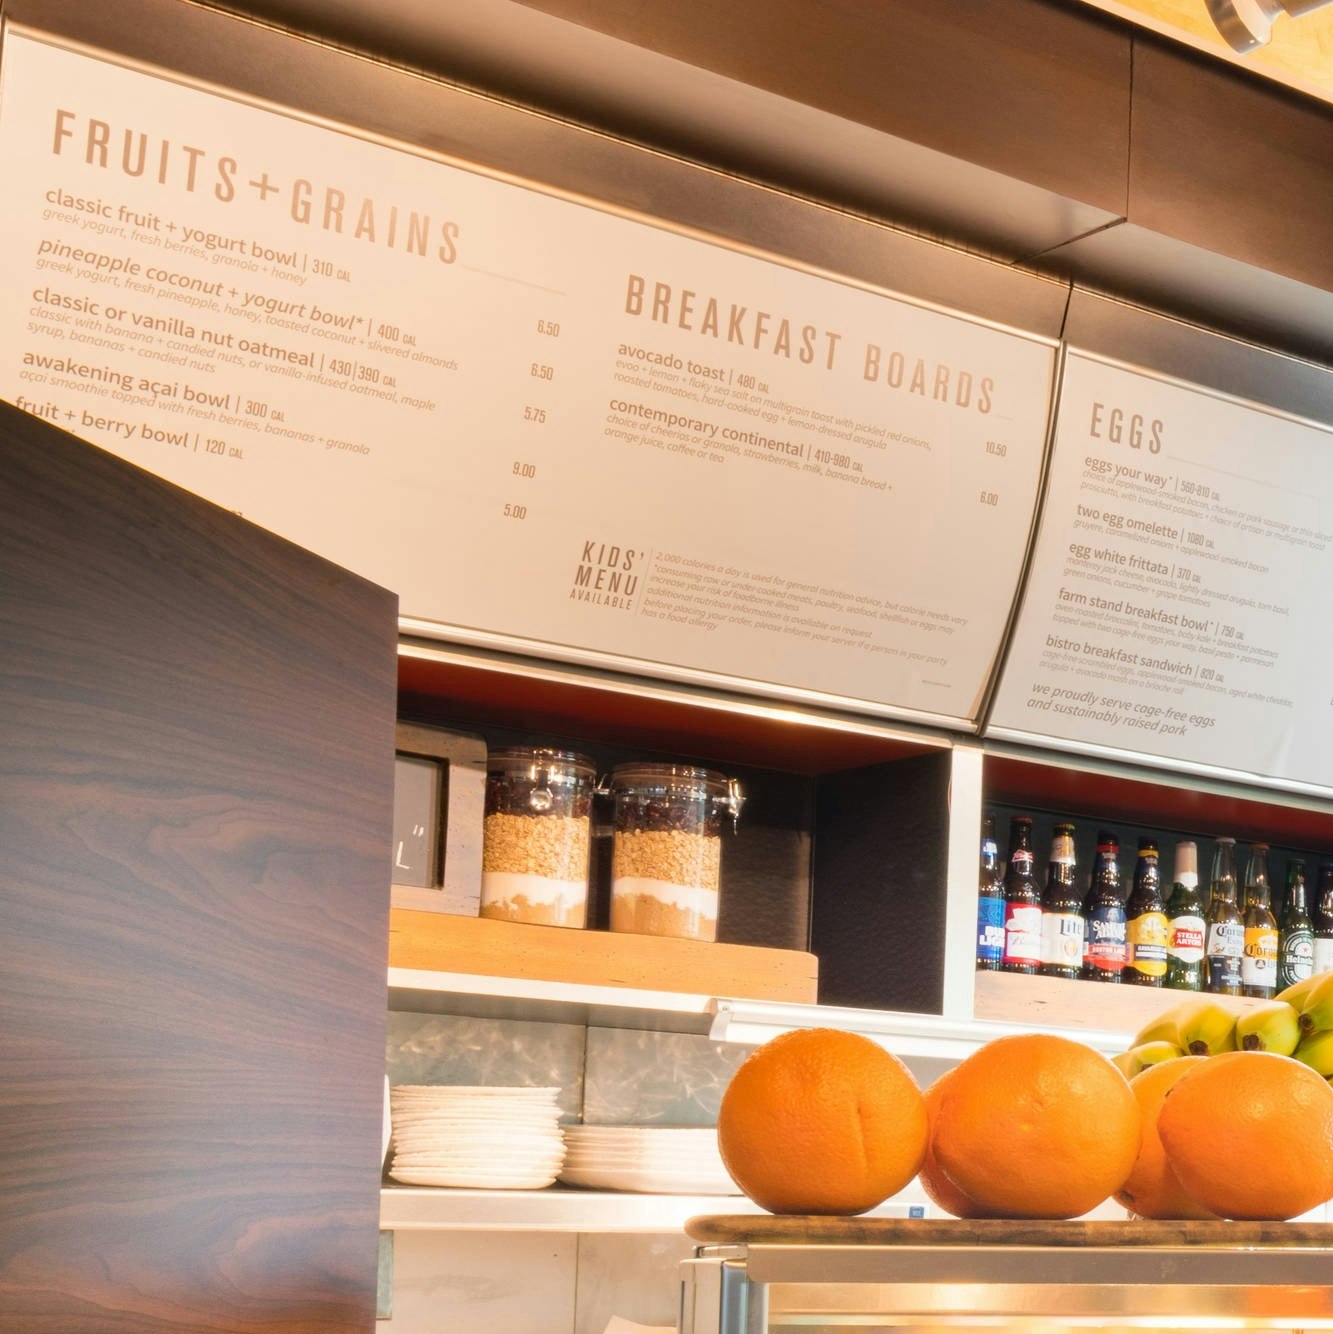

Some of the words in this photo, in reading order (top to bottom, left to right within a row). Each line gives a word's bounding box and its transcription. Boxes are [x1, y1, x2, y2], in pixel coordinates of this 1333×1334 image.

[46, 189, 112, 218] classic
[118, 205, 160, 232] fruit
[182, 226, 246, 255] yogurt
[252, 241, 297, 268] bowl
[312, 259, 333, 277] 310
[37, 239, 141, 275] pineapple
[146, 266, 224, 296] coconut
[243, 291, 306, 317] yogurt
[378, 324, 399, 342] 400
[33, 287, 99, 315] classic
[105, 307, 126, 321] or
[132, 311, 195, 338] vanilla
[201, 329, 234, 349] nut
[238, 341, 314, 368] oatmeal
[537, 320, 560, 338] 6.50
[625, 274, 842, 370] BREAKFAST
[864, 343, 994, 414] BOARDS
[23, 353, 133, 391] awakening
[139, 376, 179, 397] açai
[183, 386, 230, 410] bowl
[245, 400, 268, 418] 300
[531, 363, 554, 381] 6.50
[618, 342, 683, 370] avocado
[687, 359, 725, 381] toast
[737, 373, 755, 390] 480
[16, 396, 59, 420] fruit
[81, 411, 136, 439] berry
[141, 423, 189, 448] bowl
[206, 439, 225, 455] 120
[524, 406, 546, 424] 5.75
[610, 398, 719, 439] contemporary
[722, 426, 804, 458] continental
[1090, 402, 1164, 455] EGGS
[512, 461, 536, 479] 9.00
[1085, 456, 1112, 473] eggs
[1115, 463, 1142, 480] your
[503, 503, 527, 520] 5.00
[1077, 503, 1100, 519] two
[1103, 511, 1124, 528] egg
[1127, 517, 1178, 539] omelette
[1069, 543, 1091, 559] egg
[1094, 545, 1127, 566] white
[1129, 555, 1169, 575] frittata
[570, 588, 633, 610] AVAILABLE
[574, 565, 637, 596] MENU
[1059, 587, 1087, 605] farm
[1089, 596, 1122, 613] stand
[1124, 603, 1178, 626] breakfast
[1046, 634, 1080, 652] bistro
[1083, 642, 1138, 666] breakfast
[1140, 652, 1192, 676] sandwich
[1026, 697, 1051, 711] and
[1053, 702, 1121, 726] sustainably
[1123, 715, 1158, 732] raised
[1160, 723, 1188, 737] pork
[1032, 683, 1049, 694] we
[1051, 688, 1098, 706] proudly
[1100, 696, 1132, 712] serve
[1134, 702, 1188, 721] cage-free
[1190, 714, 1216, 728] eggs
